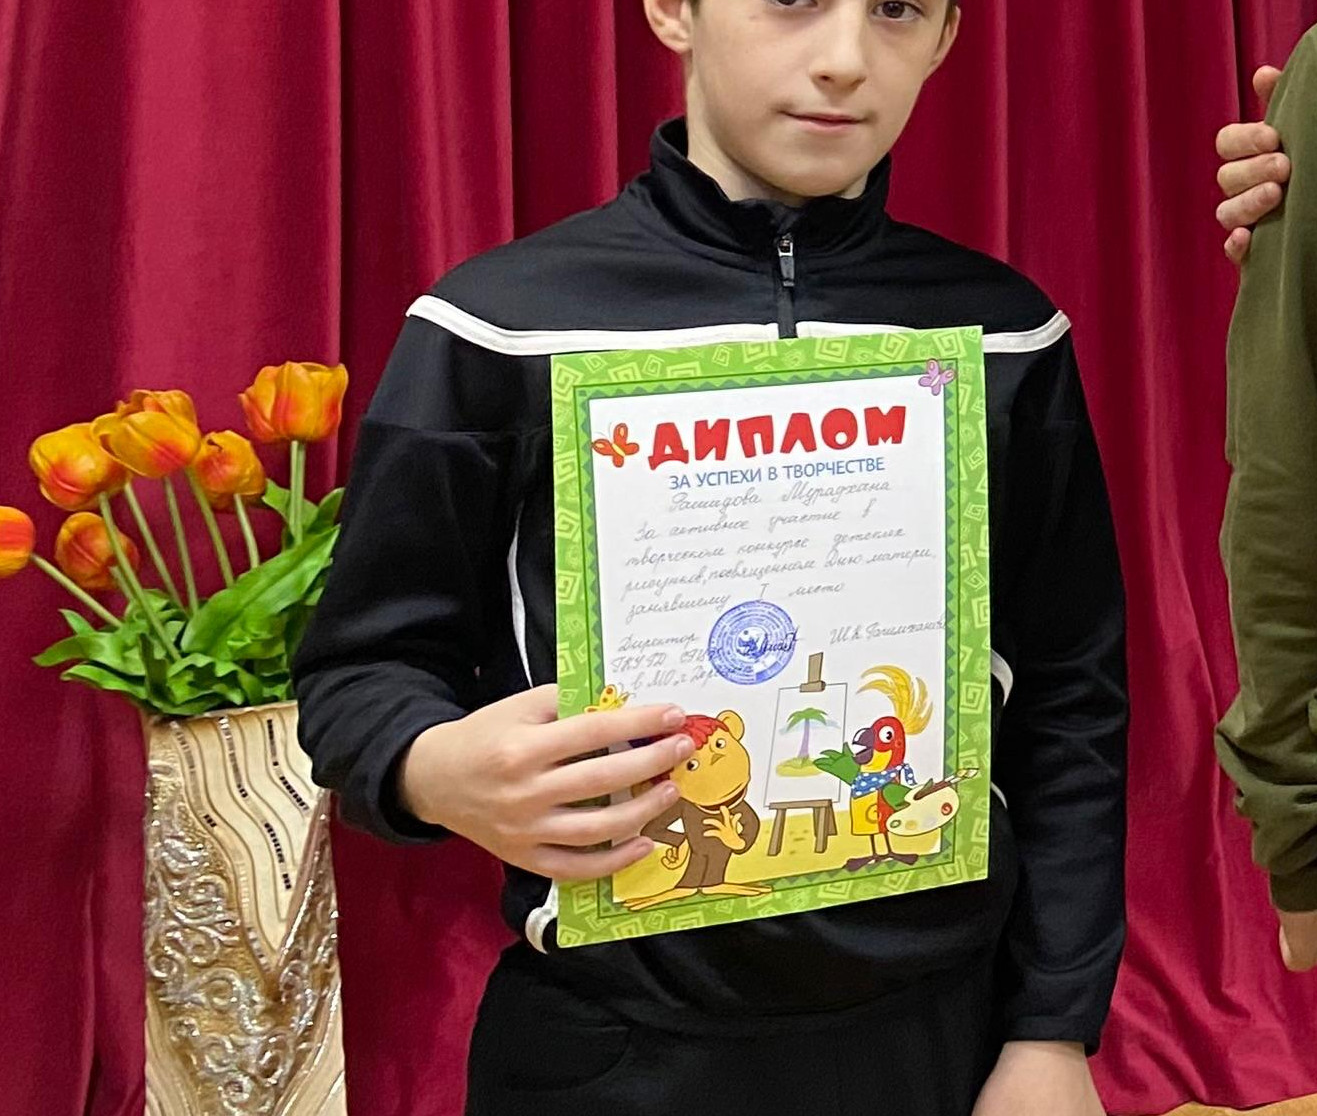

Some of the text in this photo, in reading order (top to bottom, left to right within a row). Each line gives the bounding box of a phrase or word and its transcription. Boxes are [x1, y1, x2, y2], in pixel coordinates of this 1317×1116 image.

[647, 405, 907, 471] ДИПЛОМ
[669, 456, 886, 490] ЗА УСПЕХИ В ТВОРЧЕСТВЕ
